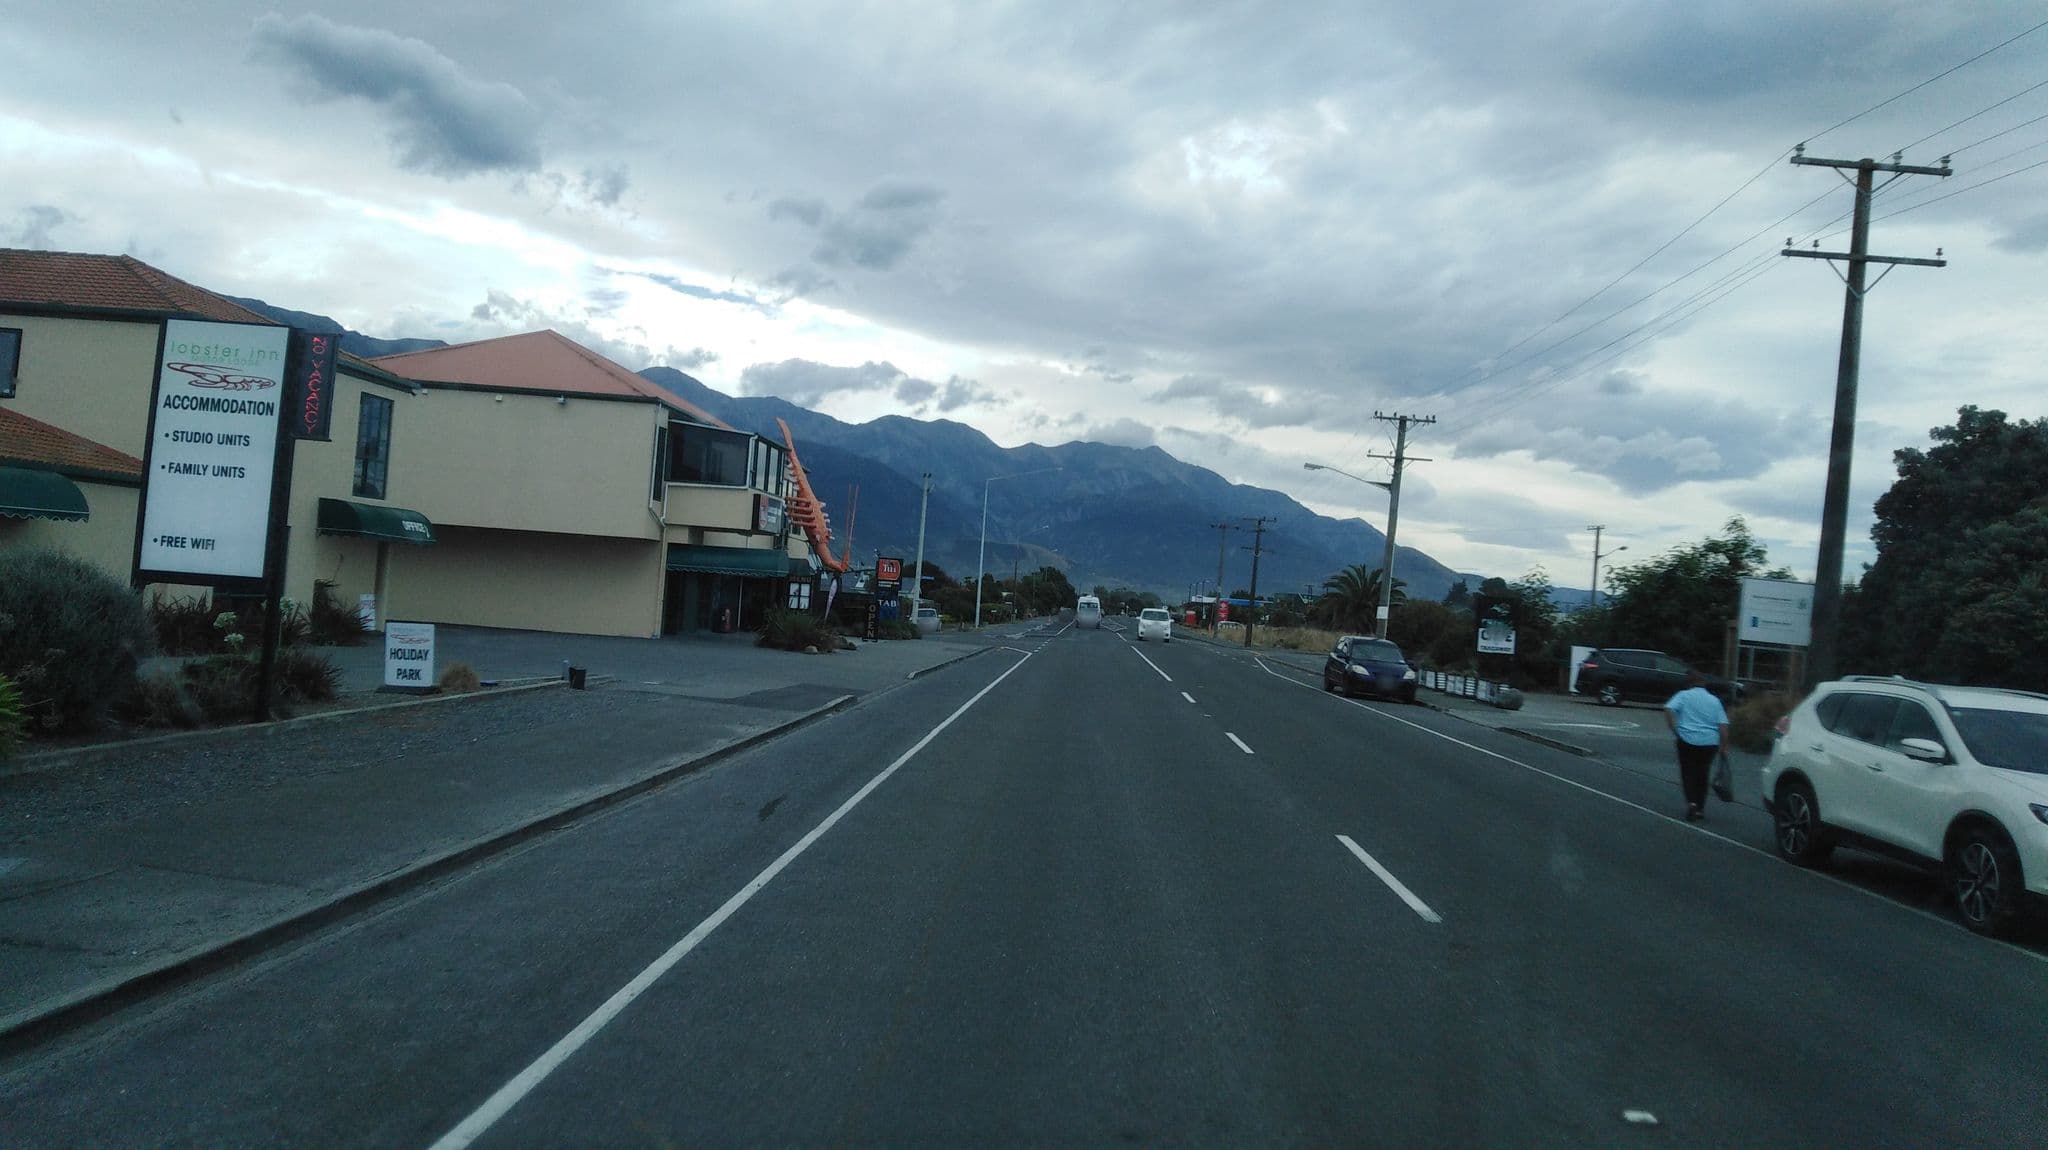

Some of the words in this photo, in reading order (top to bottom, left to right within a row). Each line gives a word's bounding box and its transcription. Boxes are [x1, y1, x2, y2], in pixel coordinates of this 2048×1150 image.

[171, 341, 240, 357] lobster
[250, 348, 279, 360] inn
[163, 394, 275, 416] ACCOMMODATION
[304, 359, 323, 434] VACANCY
[172, 430, 213, 444] STUDIO
[217, 433, 250, 447] UNITS
[168, 462, 209, 476] FAMILY
[212, 465, 246, 479] UNITS
[402, 520, 426, 533] OFFICE
[160, 535, 187, 549] FREE
[191, 537, 215, 551] WIFI
[878, 599, 897, 608] TAB
[867, 604, 877, 638] OPEN
[389, 647, 430, 661] HOLIDAY
[396, 667, 422, 681] PARK
